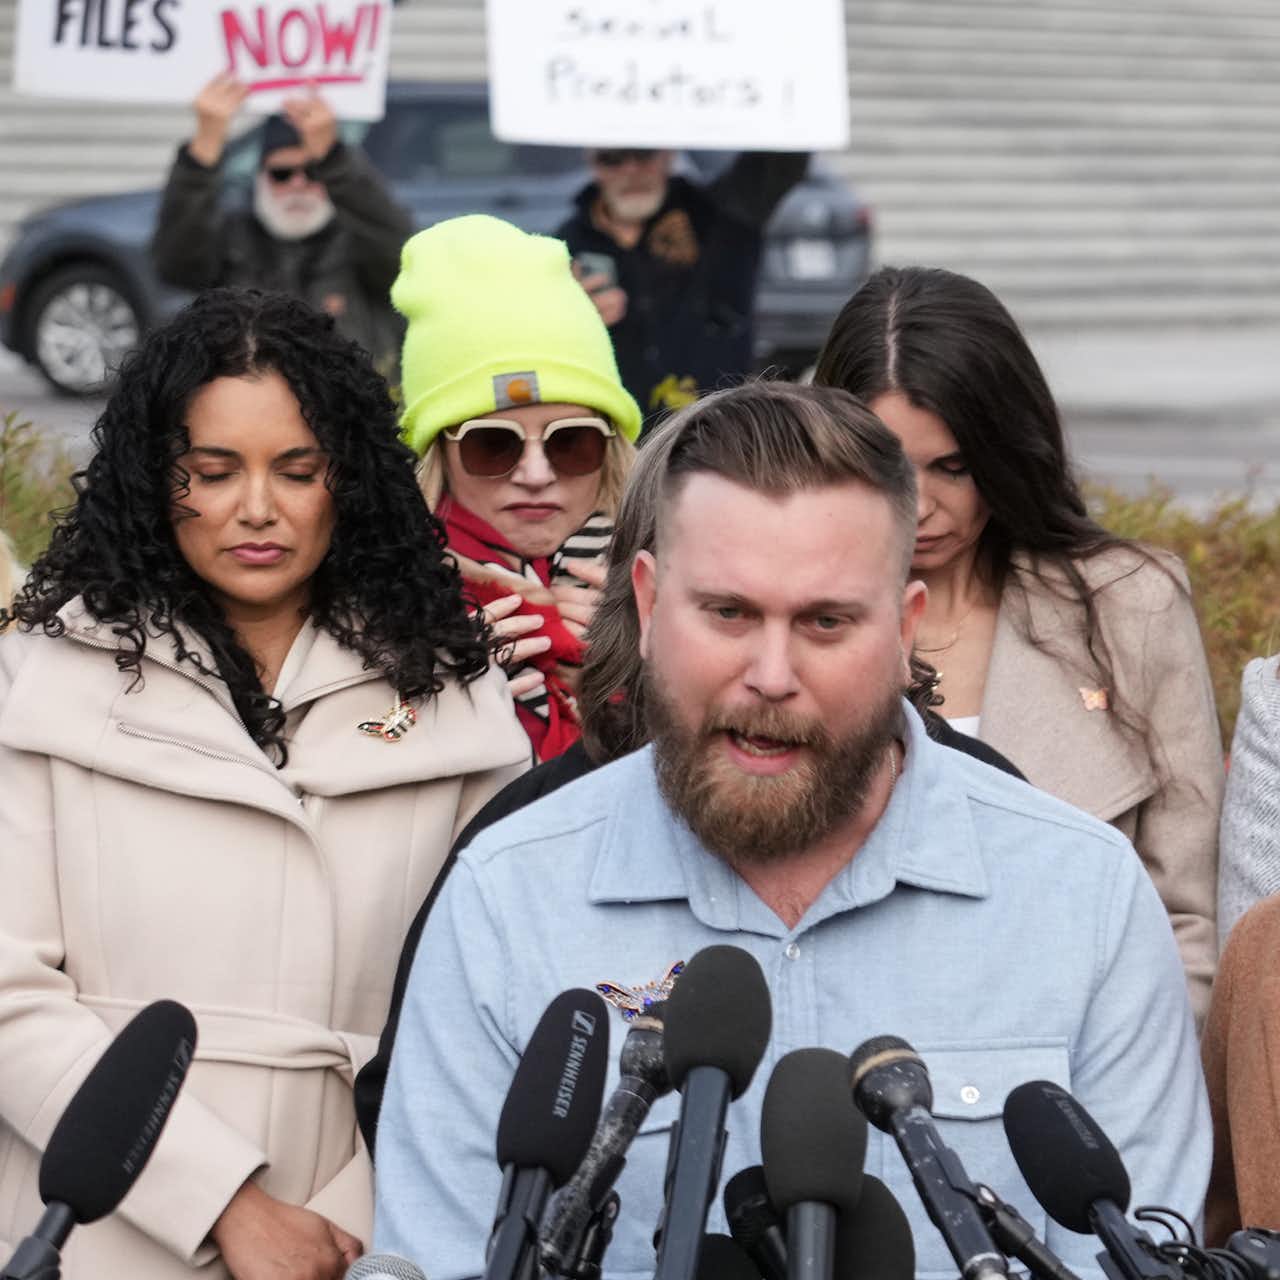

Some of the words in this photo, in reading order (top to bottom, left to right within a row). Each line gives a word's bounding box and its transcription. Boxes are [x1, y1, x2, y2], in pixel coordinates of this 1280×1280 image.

[54, 0, 180, 51] FILES
[220, 3, 384, 74] NOW!
[552, 1034, 589, 1119] SENNHEISER
